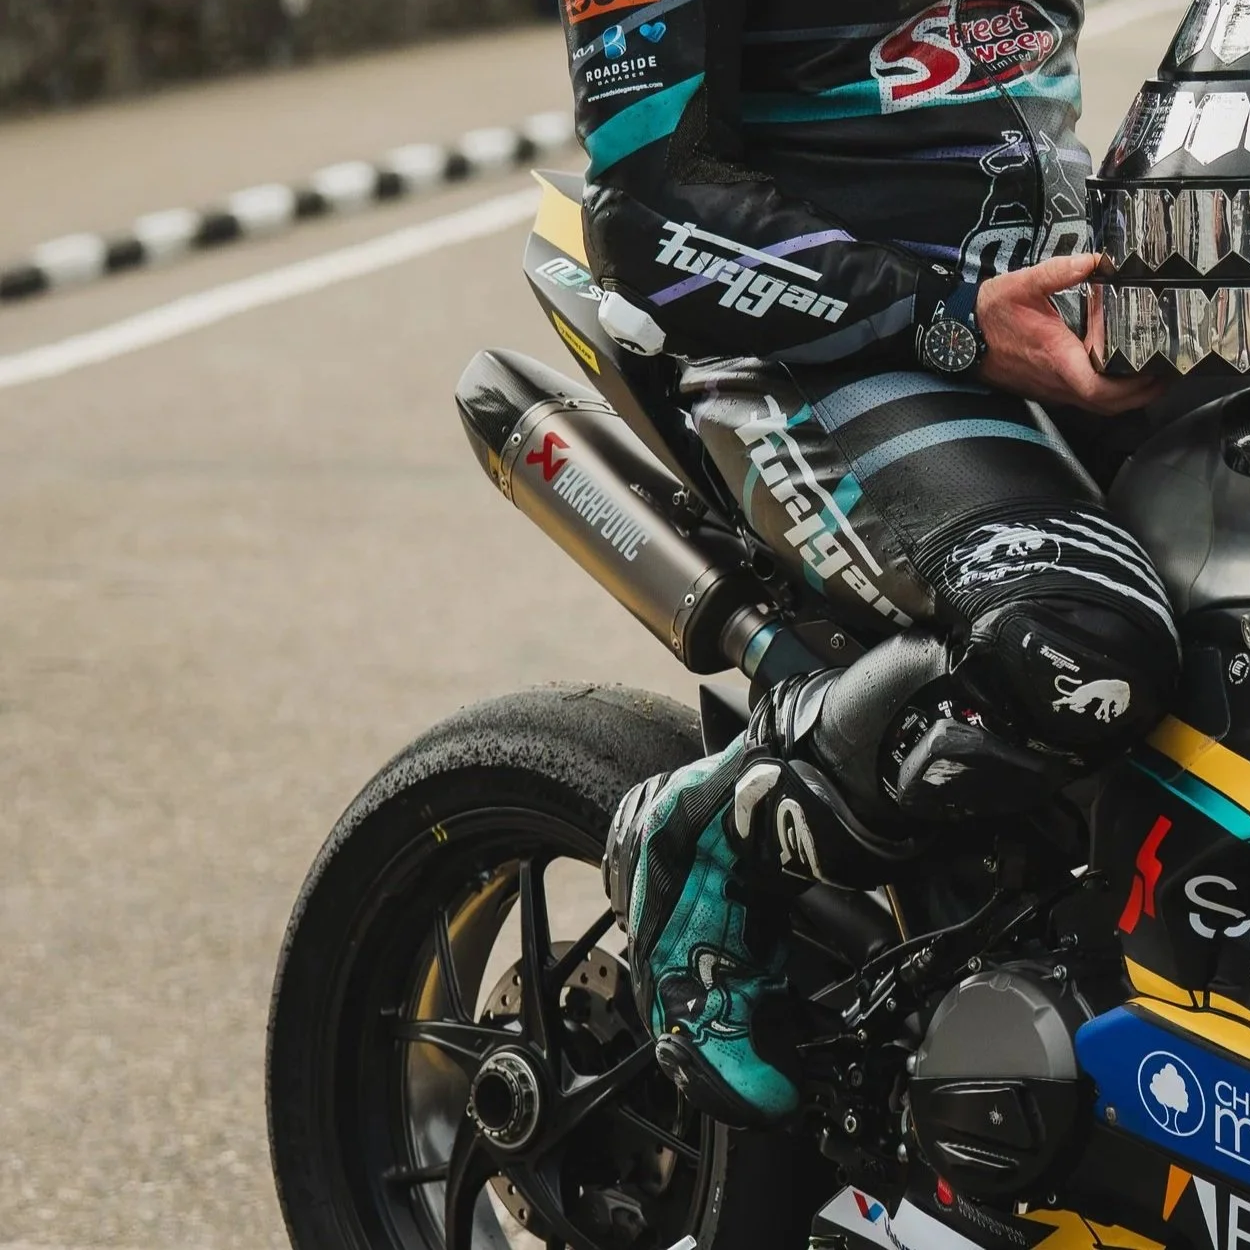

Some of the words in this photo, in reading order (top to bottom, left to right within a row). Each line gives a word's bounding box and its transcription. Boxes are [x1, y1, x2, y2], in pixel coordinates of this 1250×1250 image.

[586, 55, 657, 82] ROADSIDE
[654, 221, 849, 324] furygan
[734, 395, 915, 627] furygan
